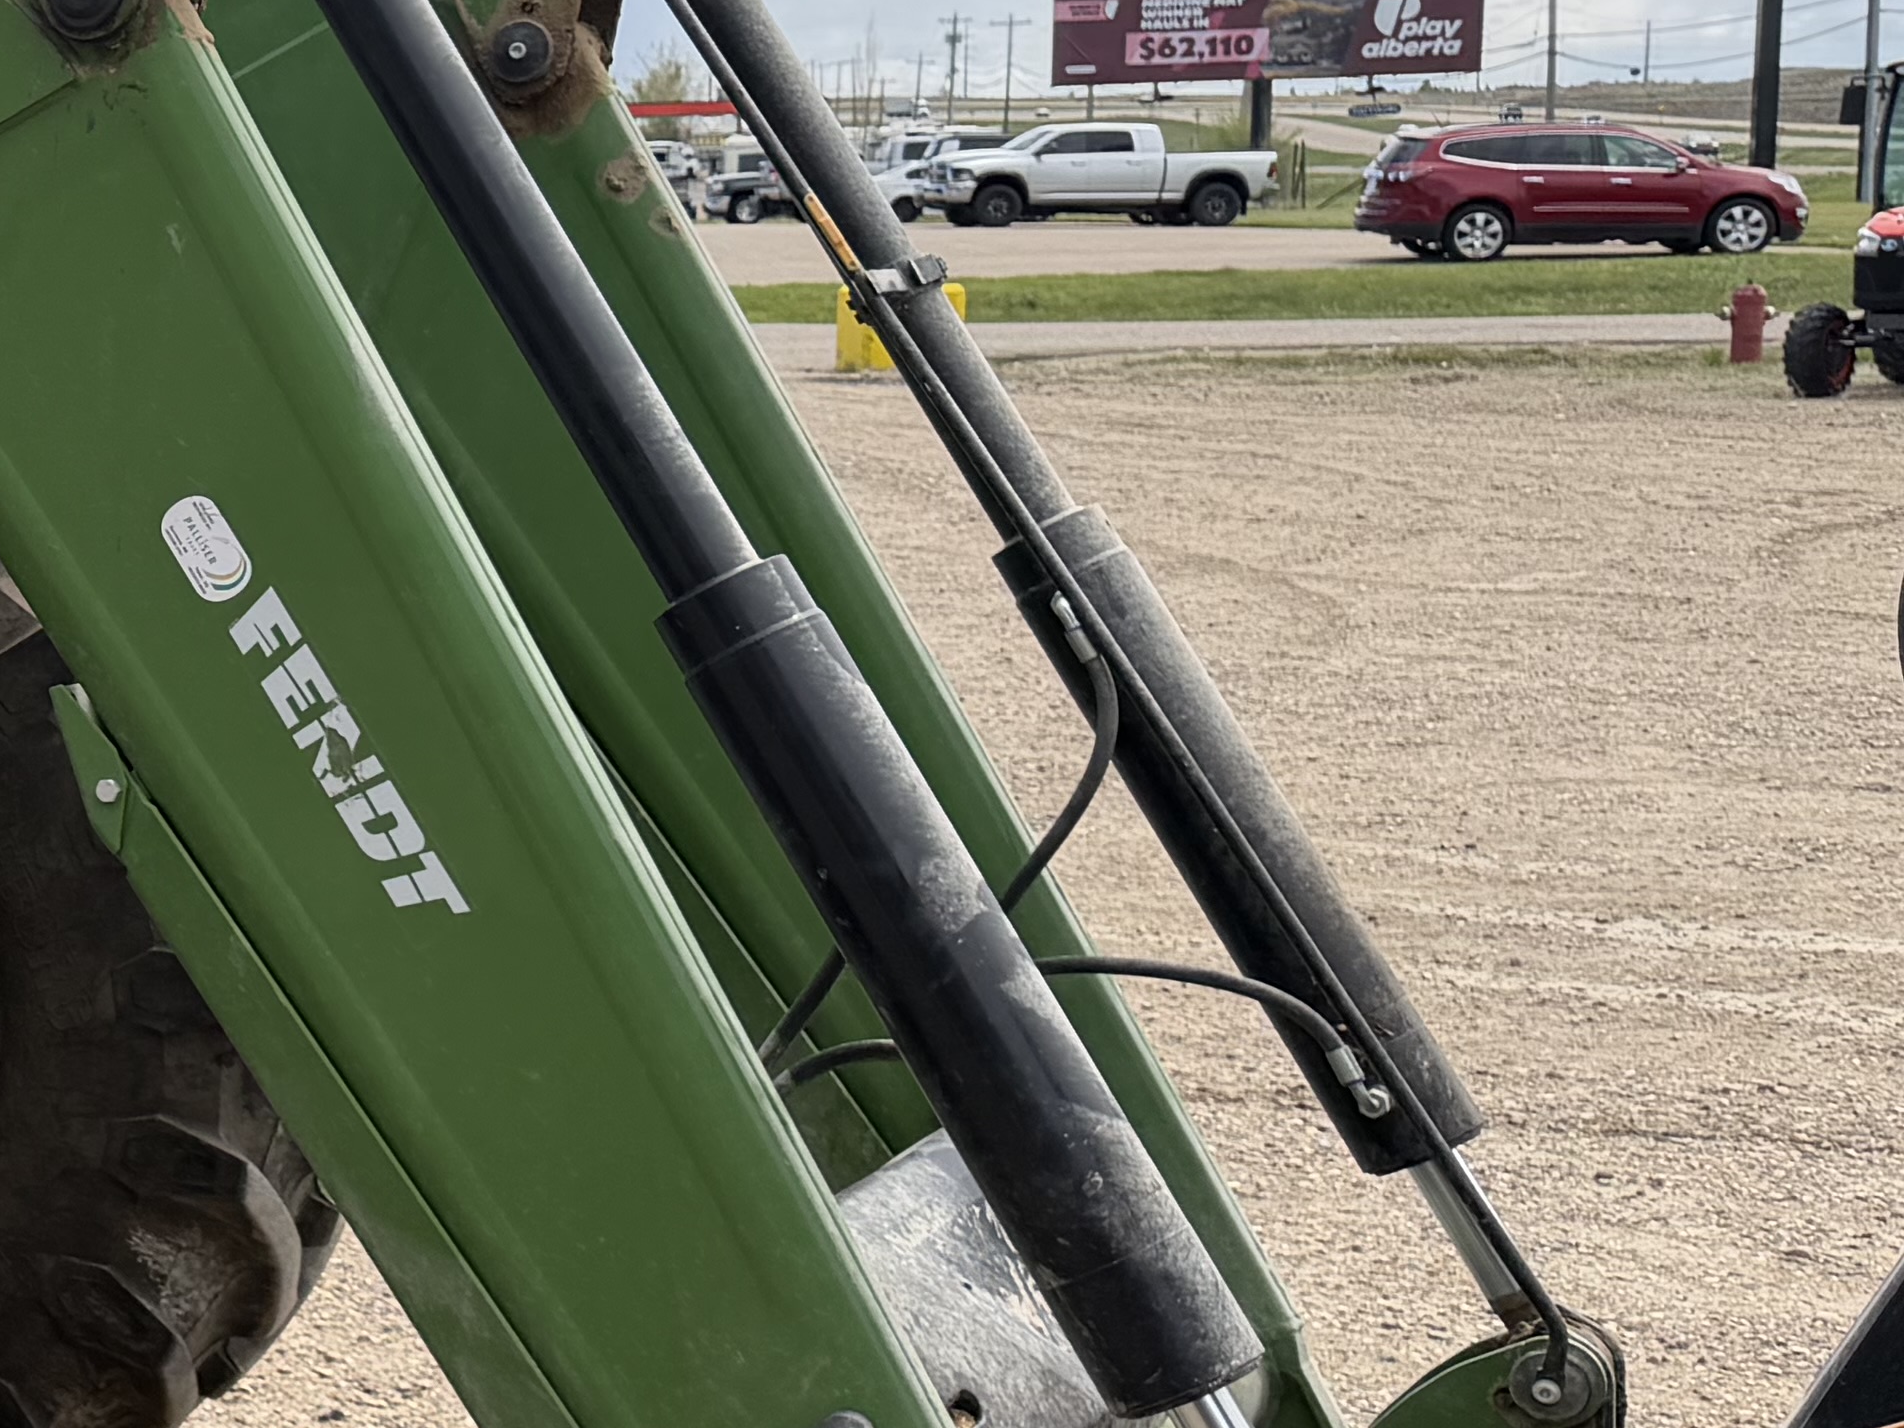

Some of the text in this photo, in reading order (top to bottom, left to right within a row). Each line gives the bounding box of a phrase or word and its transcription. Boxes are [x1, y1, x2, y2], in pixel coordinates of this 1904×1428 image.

[1398, 16, 1463, 41] play
[1138, 34, 1255, 61] $62,110
[1361, 36, 1463, 59] alberta
[228, 585, 473, 914] FENDT
